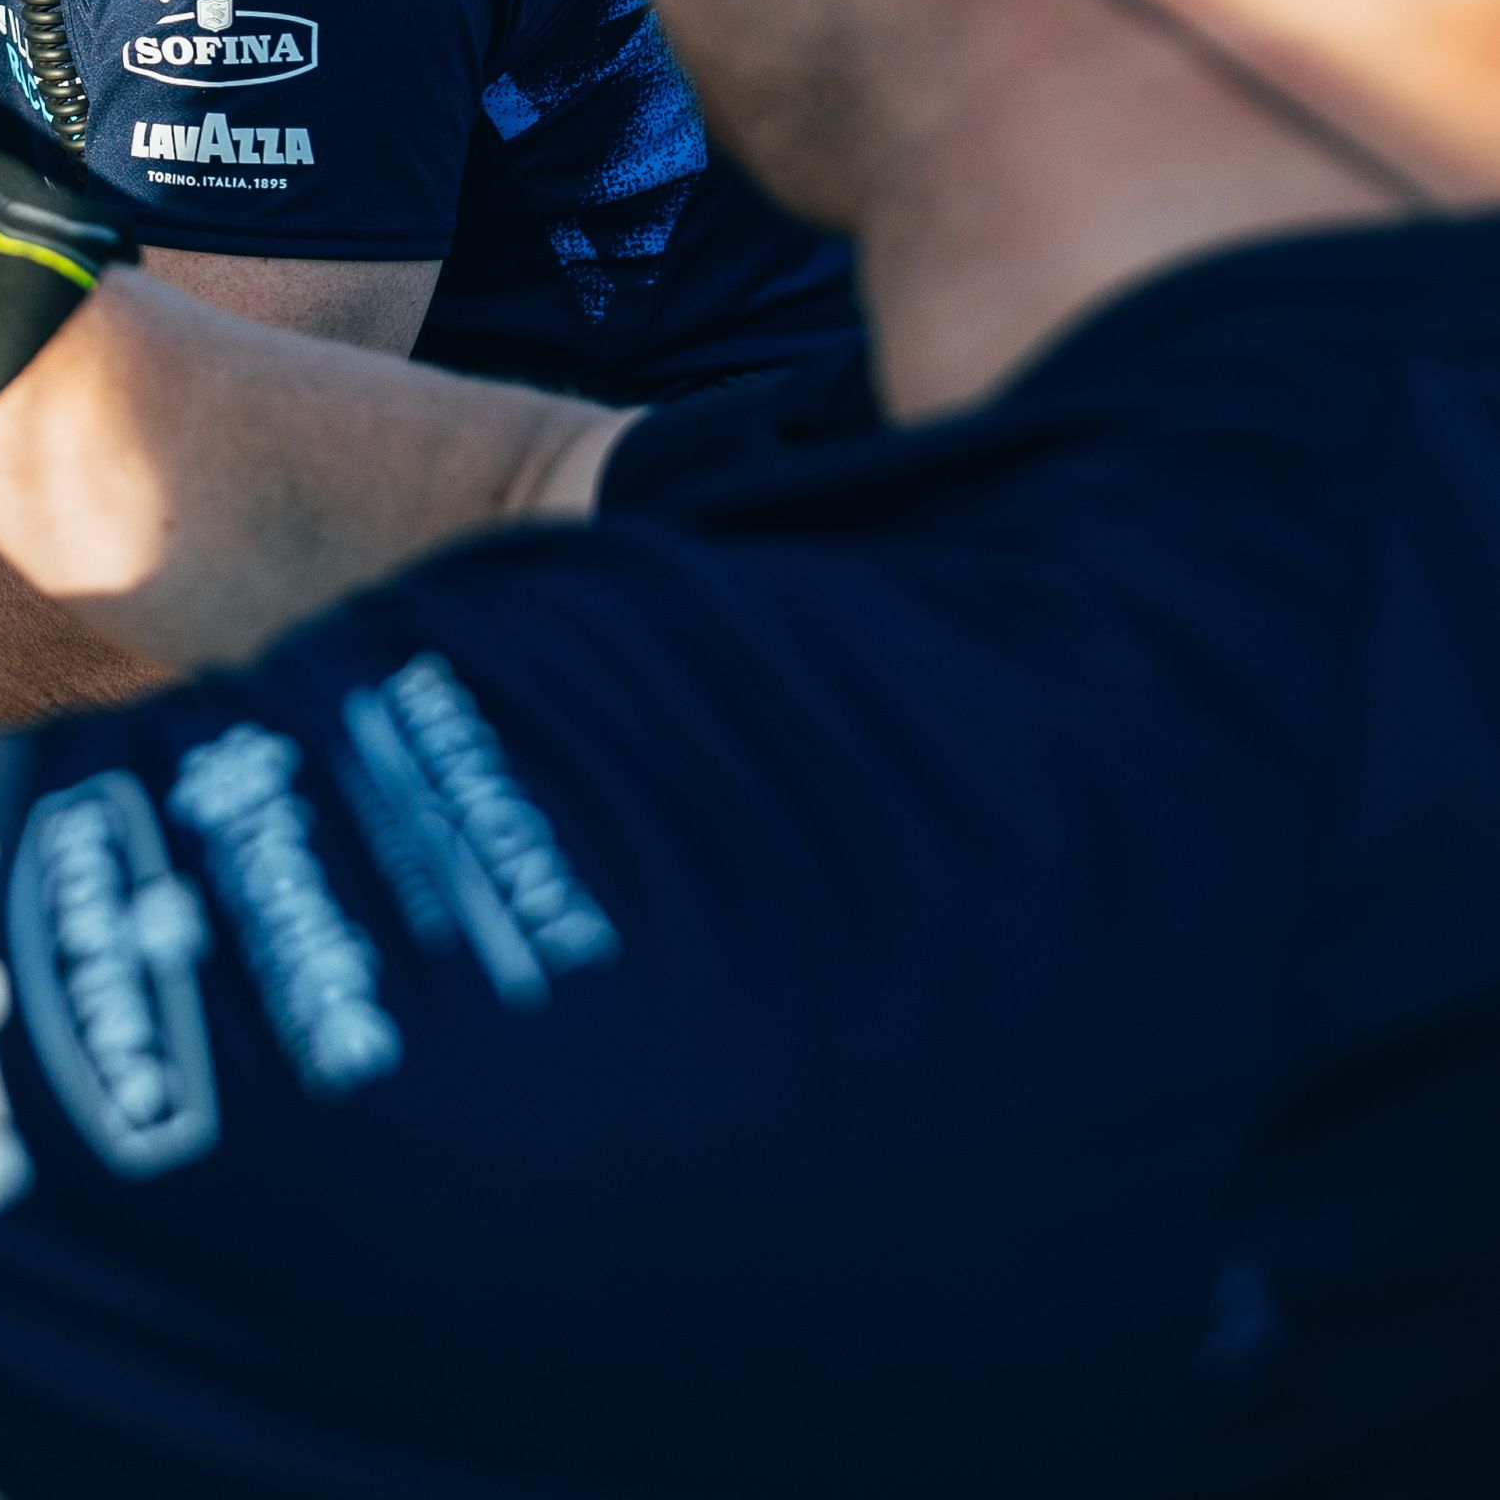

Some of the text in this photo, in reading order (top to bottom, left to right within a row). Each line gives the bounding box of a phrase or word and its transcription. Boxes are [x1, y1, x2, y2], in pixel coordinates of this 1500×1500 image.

[134, 33, 304, 66] SOFINA
[130, 112, 315, 165] LAVAZZA
[254, 178, 288, 189] 1895
